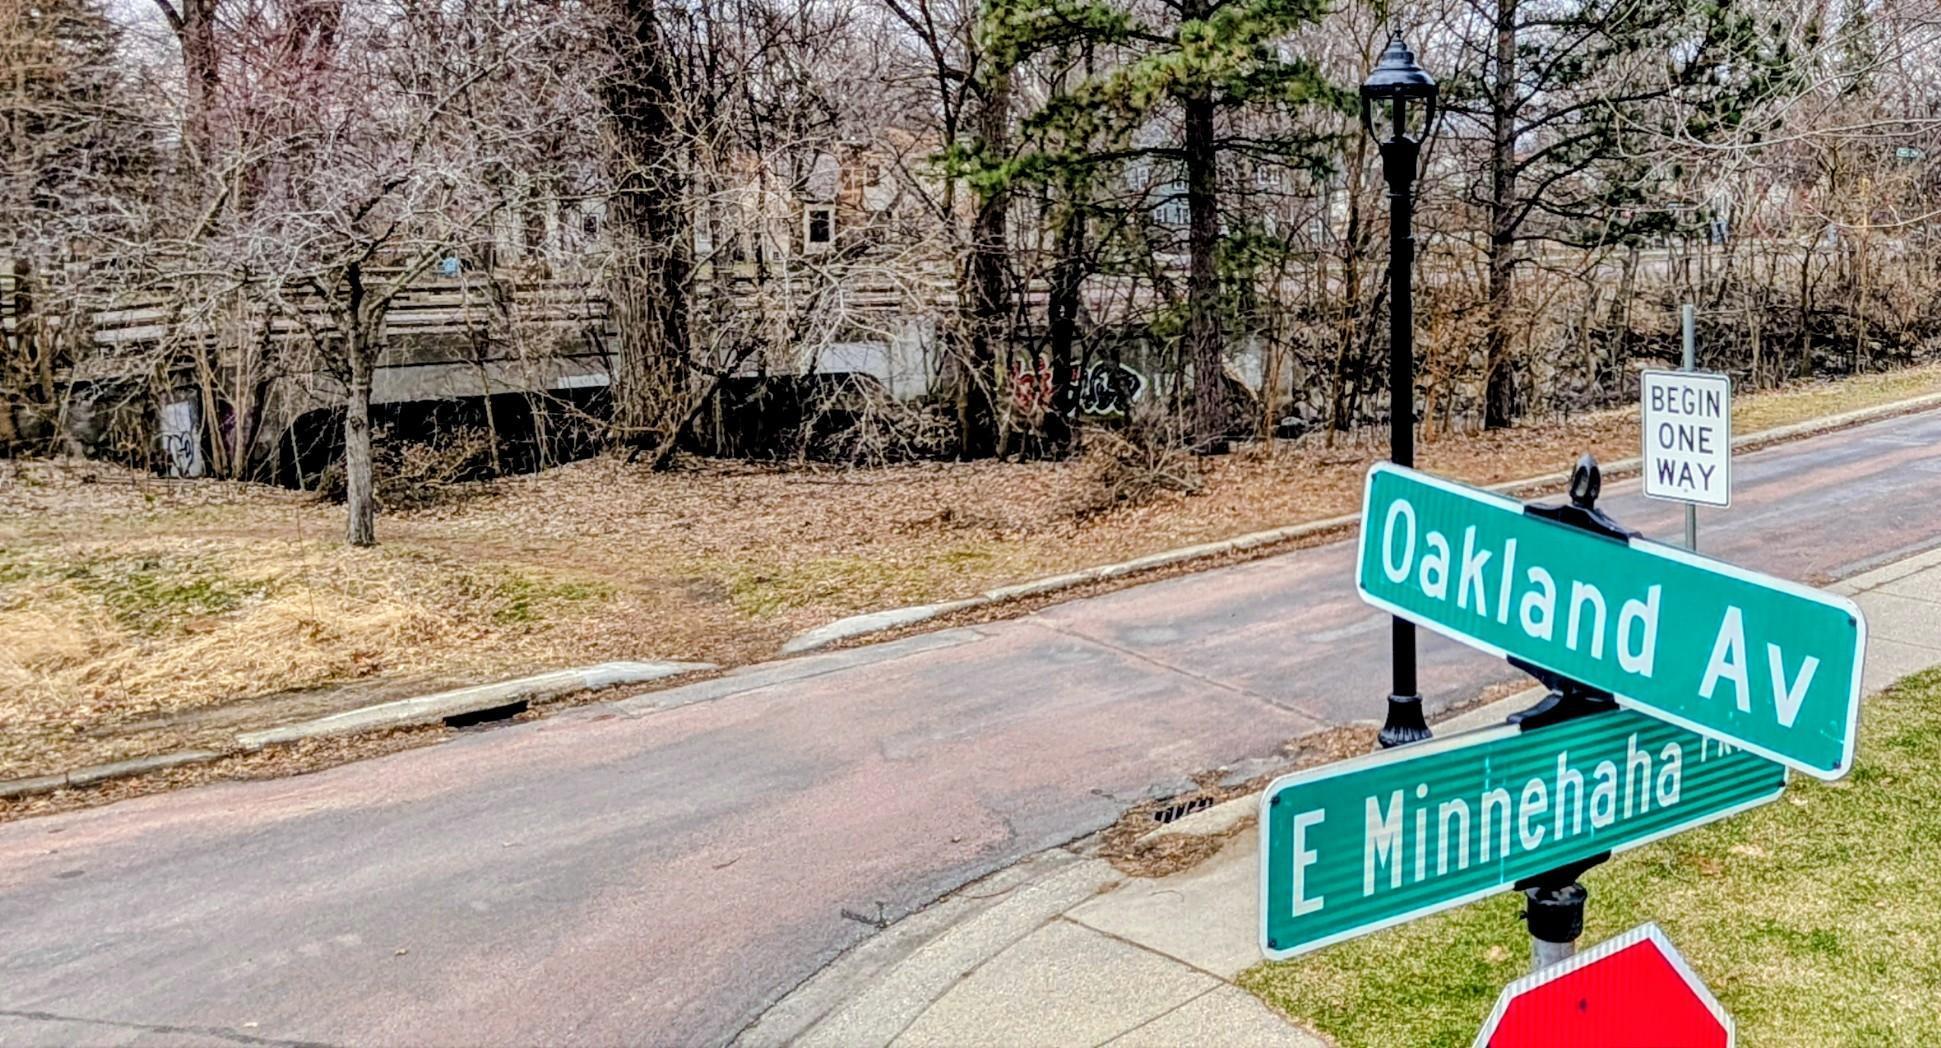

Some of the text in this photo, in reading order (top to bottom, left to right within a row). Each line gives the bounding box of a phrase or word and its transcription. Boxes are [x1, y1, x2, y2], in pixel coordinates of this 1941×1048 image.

[1651, 385, 1720, 418] BEGIN
[1659, 422, 1713, 454] ONE
[1656, 457, 1716, 491] WAY
[1381, 499, 1820, 728] Oakland Av
[1292, 733, 1683, 917] E Minnehaha
